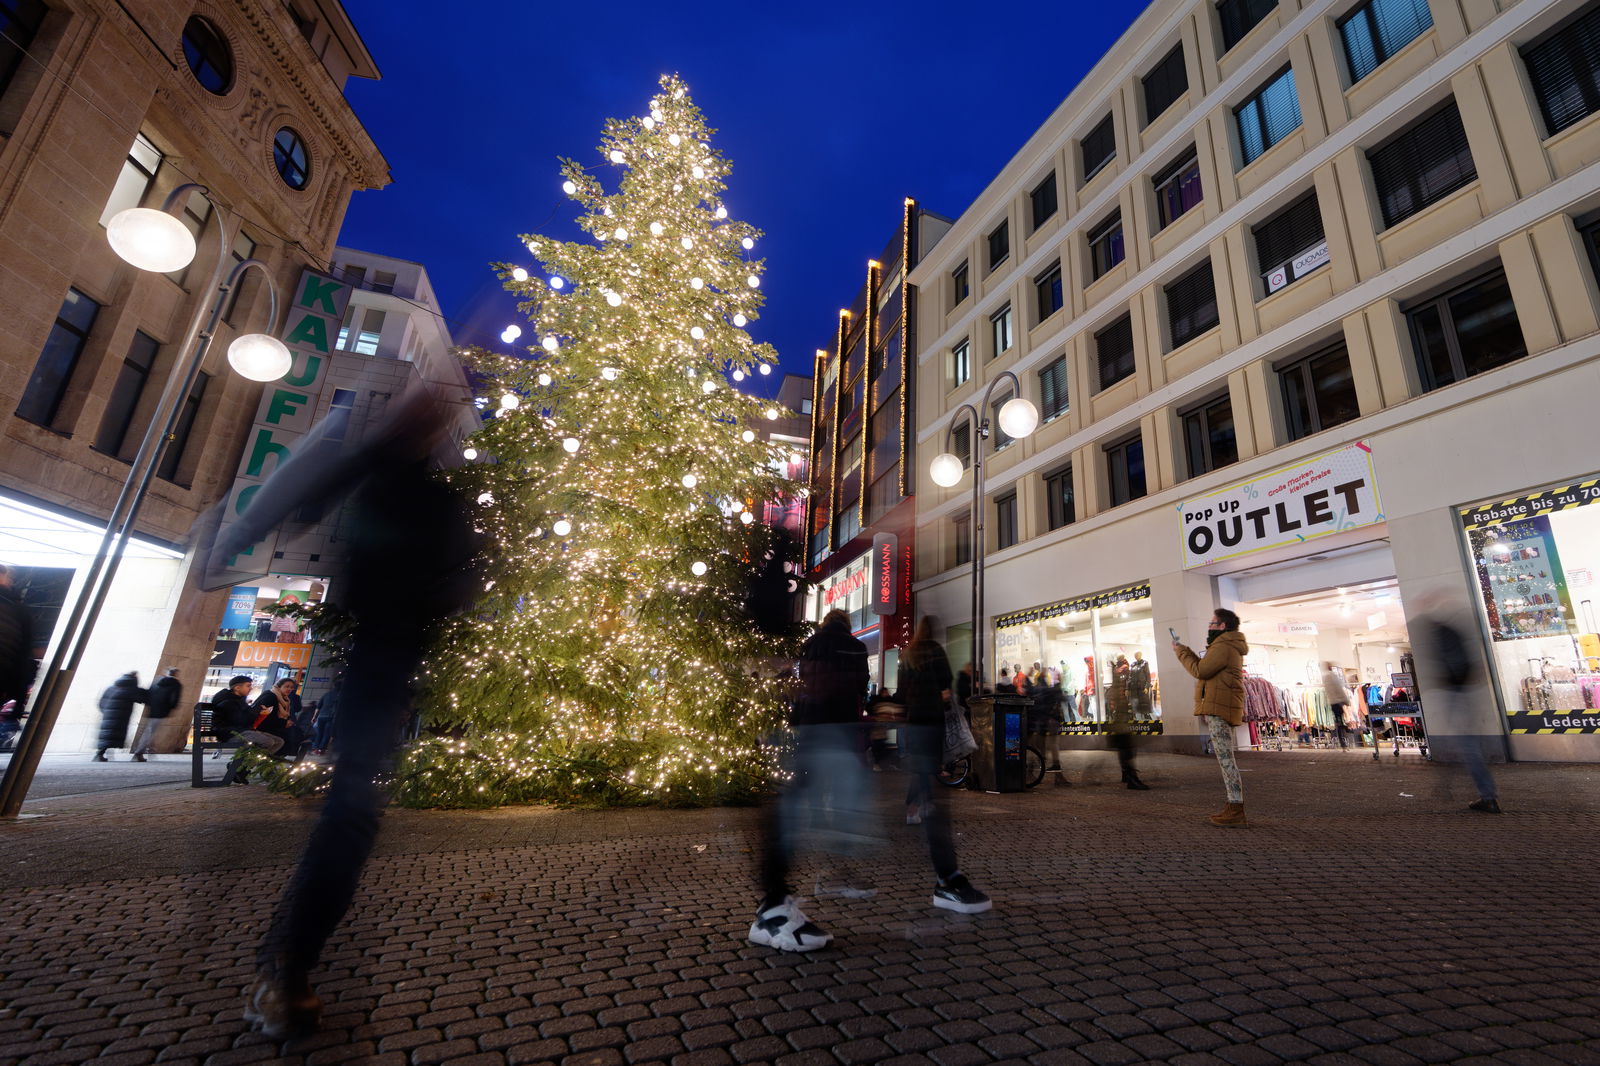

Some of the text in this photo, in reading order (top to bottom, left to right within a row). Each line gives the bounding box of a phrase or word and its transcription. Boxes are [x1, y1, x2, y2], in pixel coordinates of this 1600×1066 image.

[227, 275, 342, 567] KAUFh
[1189, 478, 1365, 555] OUTLET
[1473, 504, 1527, 524] Rabatte
[1532, 498, 1554, 512] bis
[1559, 493, 1576, 505] zu
[880, 543, 893, 603] ROSSMANN
[1108, 596, 1118, 604] für
[1118, 592, 1134, 602] kurze
[1135, 589, 1147, 597] Zeit
[241, 646, 309, 663] OUTLET
